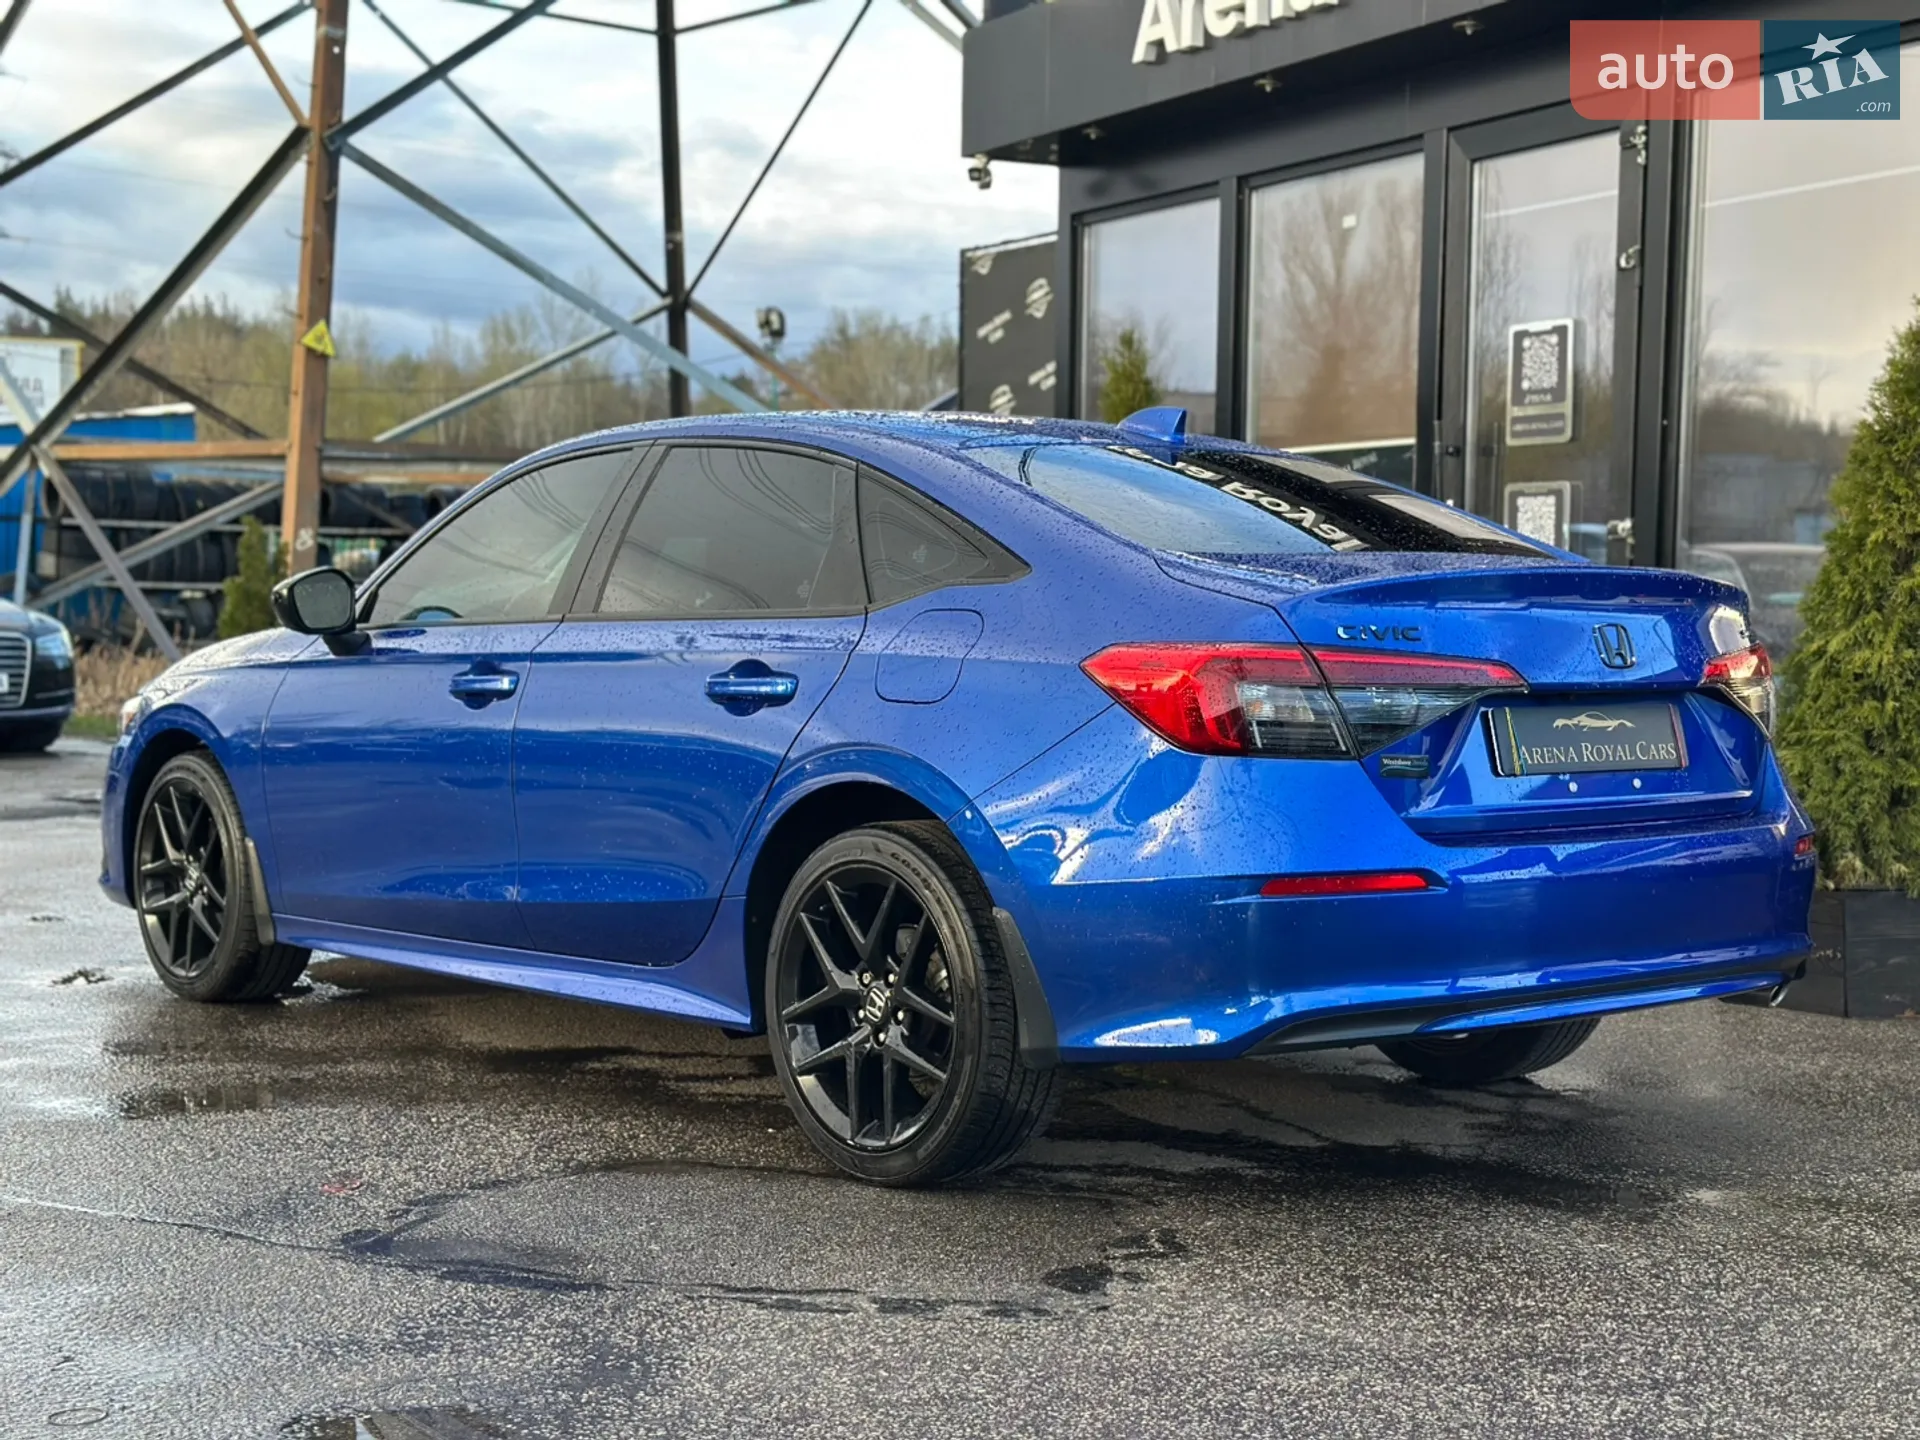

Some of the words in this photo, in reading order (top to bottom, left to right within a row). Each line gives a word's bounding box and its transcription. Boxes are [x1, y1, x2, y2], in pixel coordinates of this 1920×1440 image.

[1132, 0, 1340, 64] Are
[1336, 624, 1422, 642] CIVIC
[1581, 742, 1635, 762] ROYAL
[1636, 740, 1677, 760] CARS
